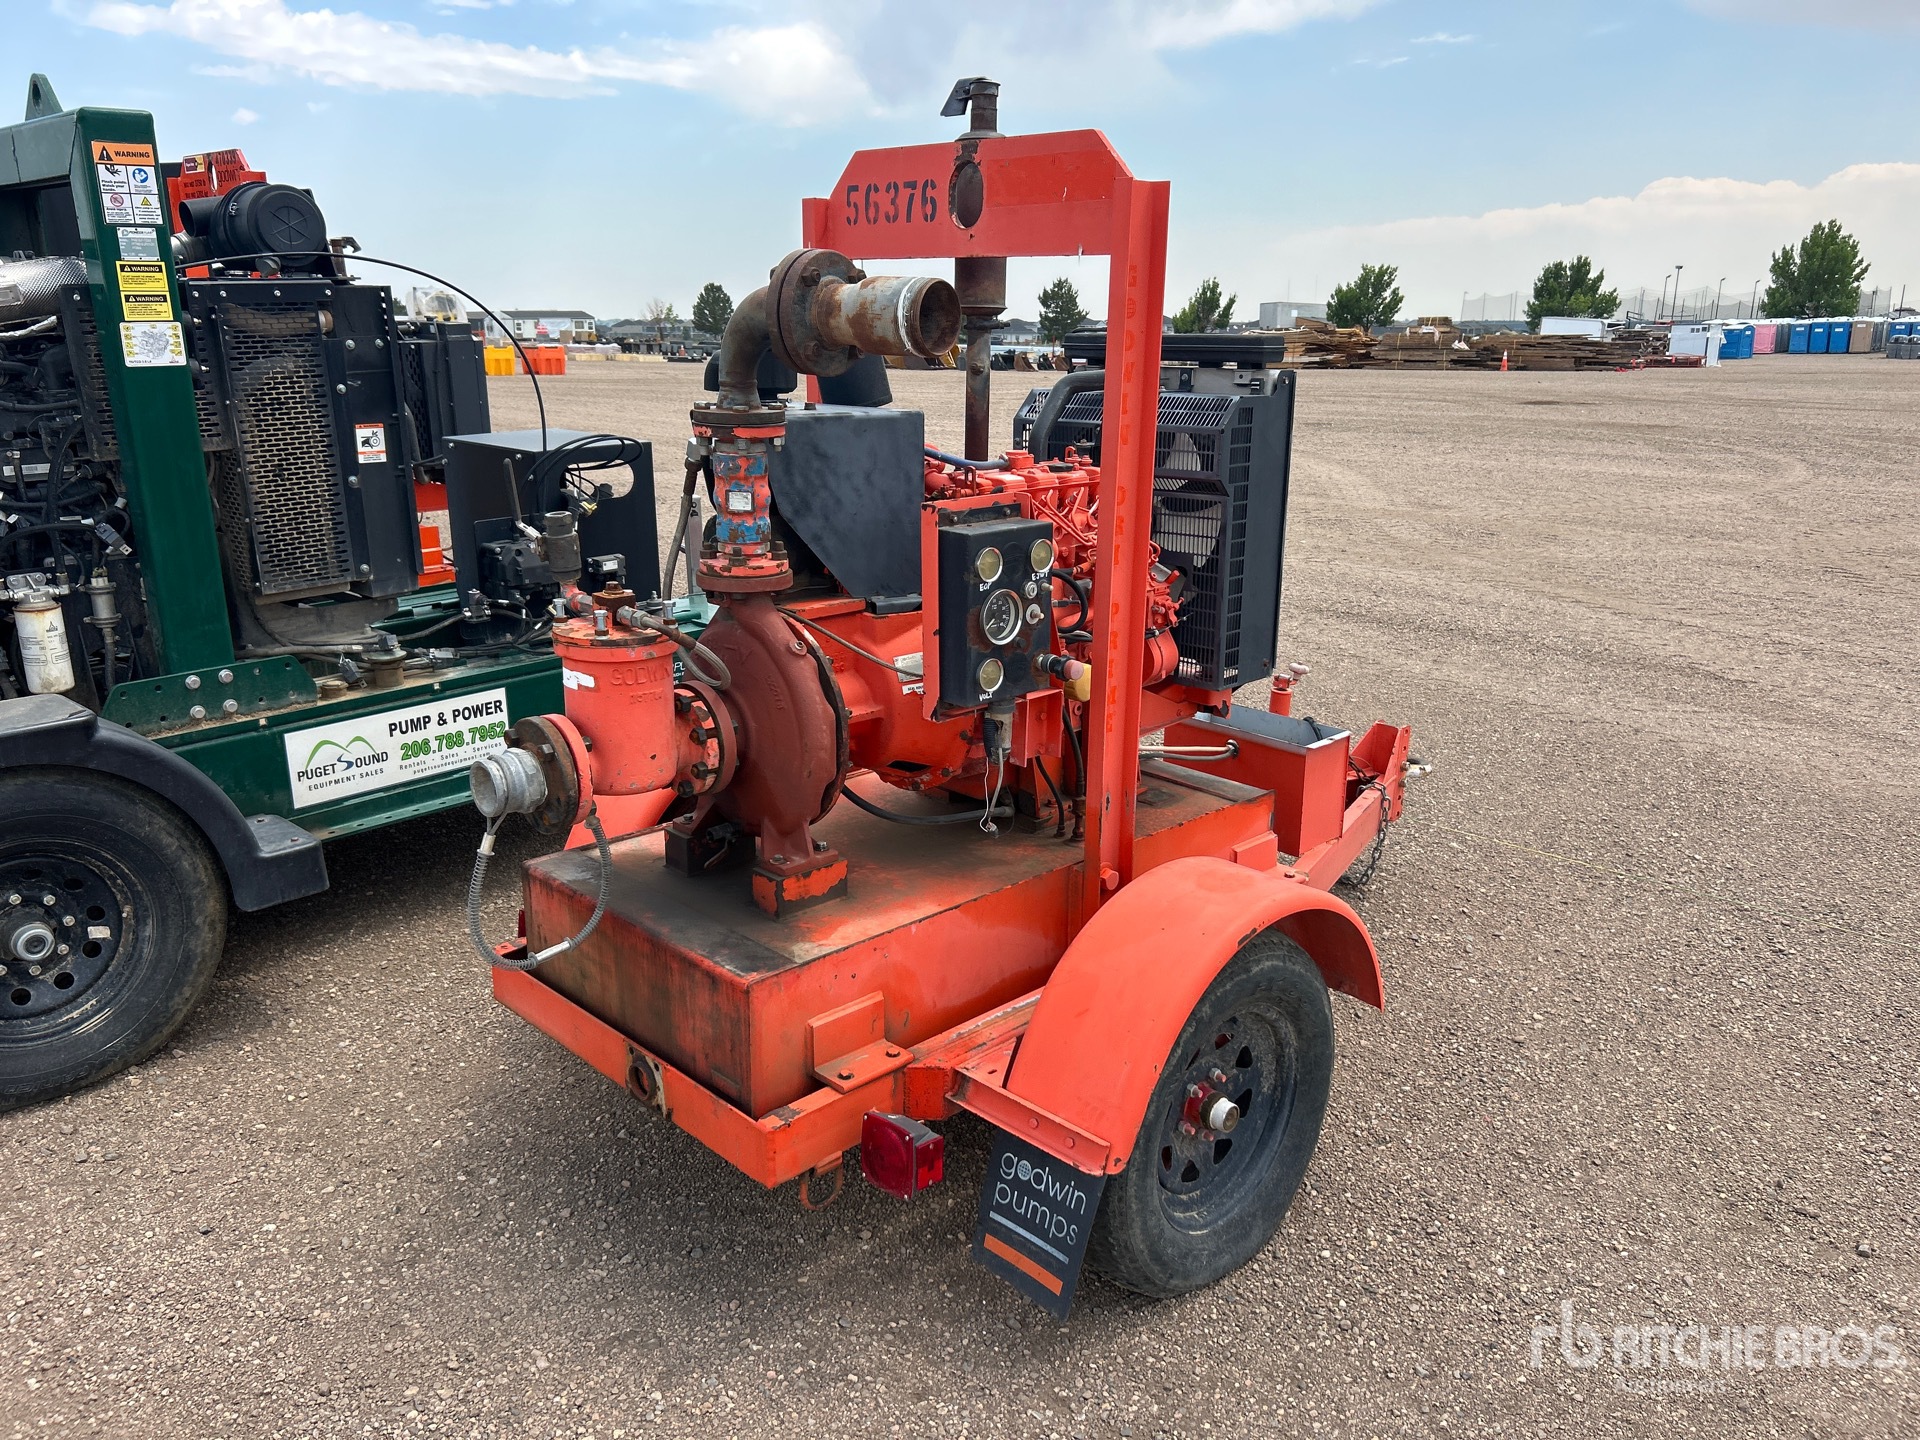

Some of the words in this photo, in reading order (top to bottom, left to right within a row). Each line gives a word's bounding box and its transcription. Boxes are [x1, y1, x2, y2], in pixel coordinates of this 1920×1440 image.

[114, 150, 150, 159] WARNING
[846, 178, 938, 226] 56376
[388, 714, 432, 738] PUMP
[437, 712, 448, 727] &
[452, 699, 504, 723] POWER
[399, 760, 426, 770] Rentals
[440, 752, 459, 760] Sales
[472, 742, 502, 753] Services
[400, 720, 507, 761] 206.788.7952
[297, 762, 337, 783] PUGET
[337, 752, 389, 772] SOUND
[308, 774, 357, 792] EQUIPMENT
[359, 768, 384, 779] SALES
[1000, 1152, 1087, 1215] godwin
[992, 1181, 1079, 1246] pumps
